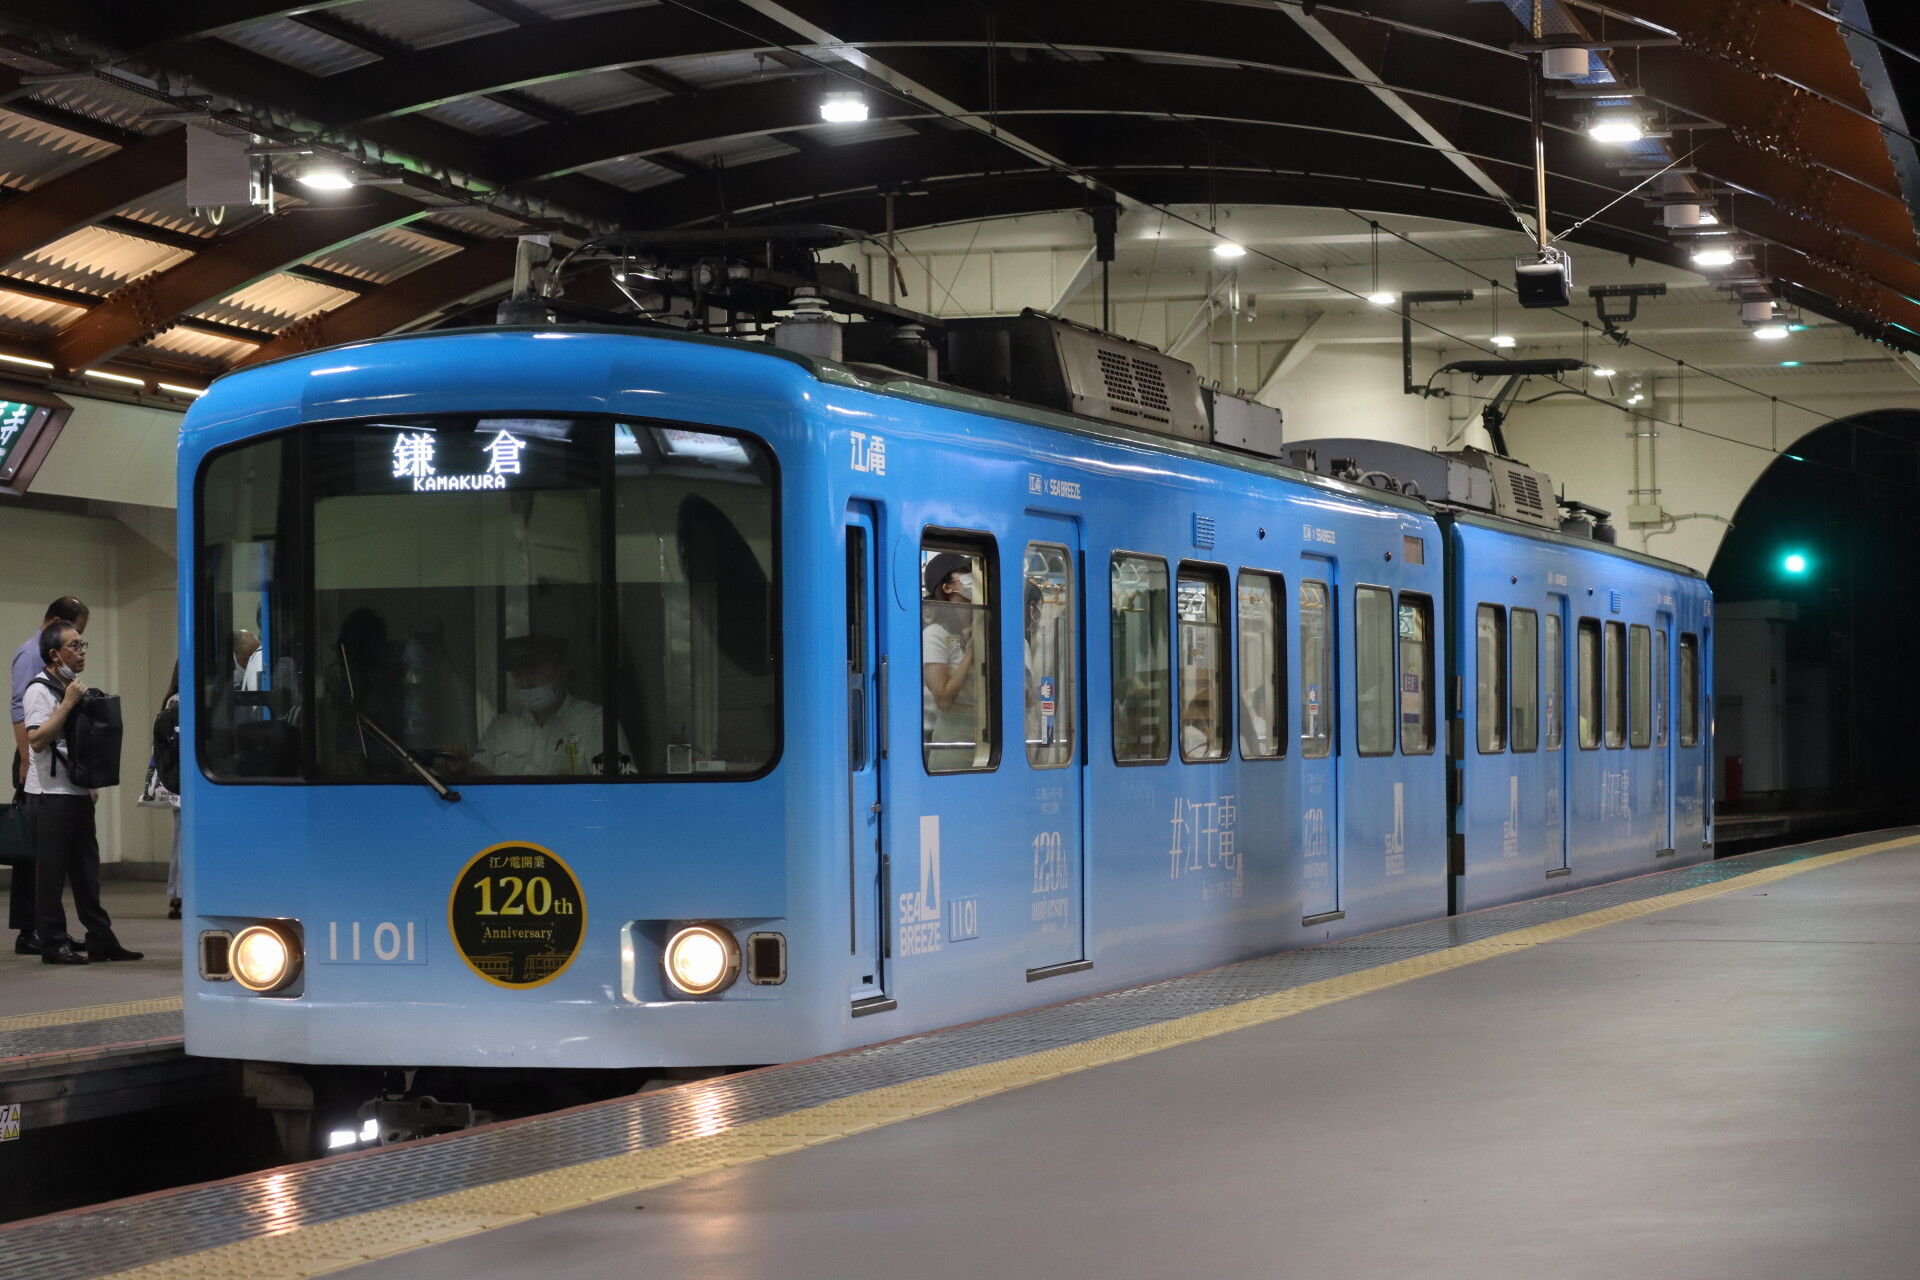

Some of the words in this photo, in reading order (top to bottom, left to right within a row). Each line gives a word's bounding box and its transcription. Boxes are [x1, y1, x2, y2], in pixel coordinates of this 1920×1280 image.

[393, 430, 526, 477] 鎌倉
[413, 475, 506, 491] KAMAKURA
[489, 856, 545, 868] 江ノ電開業
[473, 876, 573, 916] 120th
[900, 892, 921, 925] SEA
[483, 925, 553, 941] Anniversary
[952, 901, 977, 937] 1101
[329, 921, 415, 961] 1101
[901, 922, 942, 957] BREEZE
